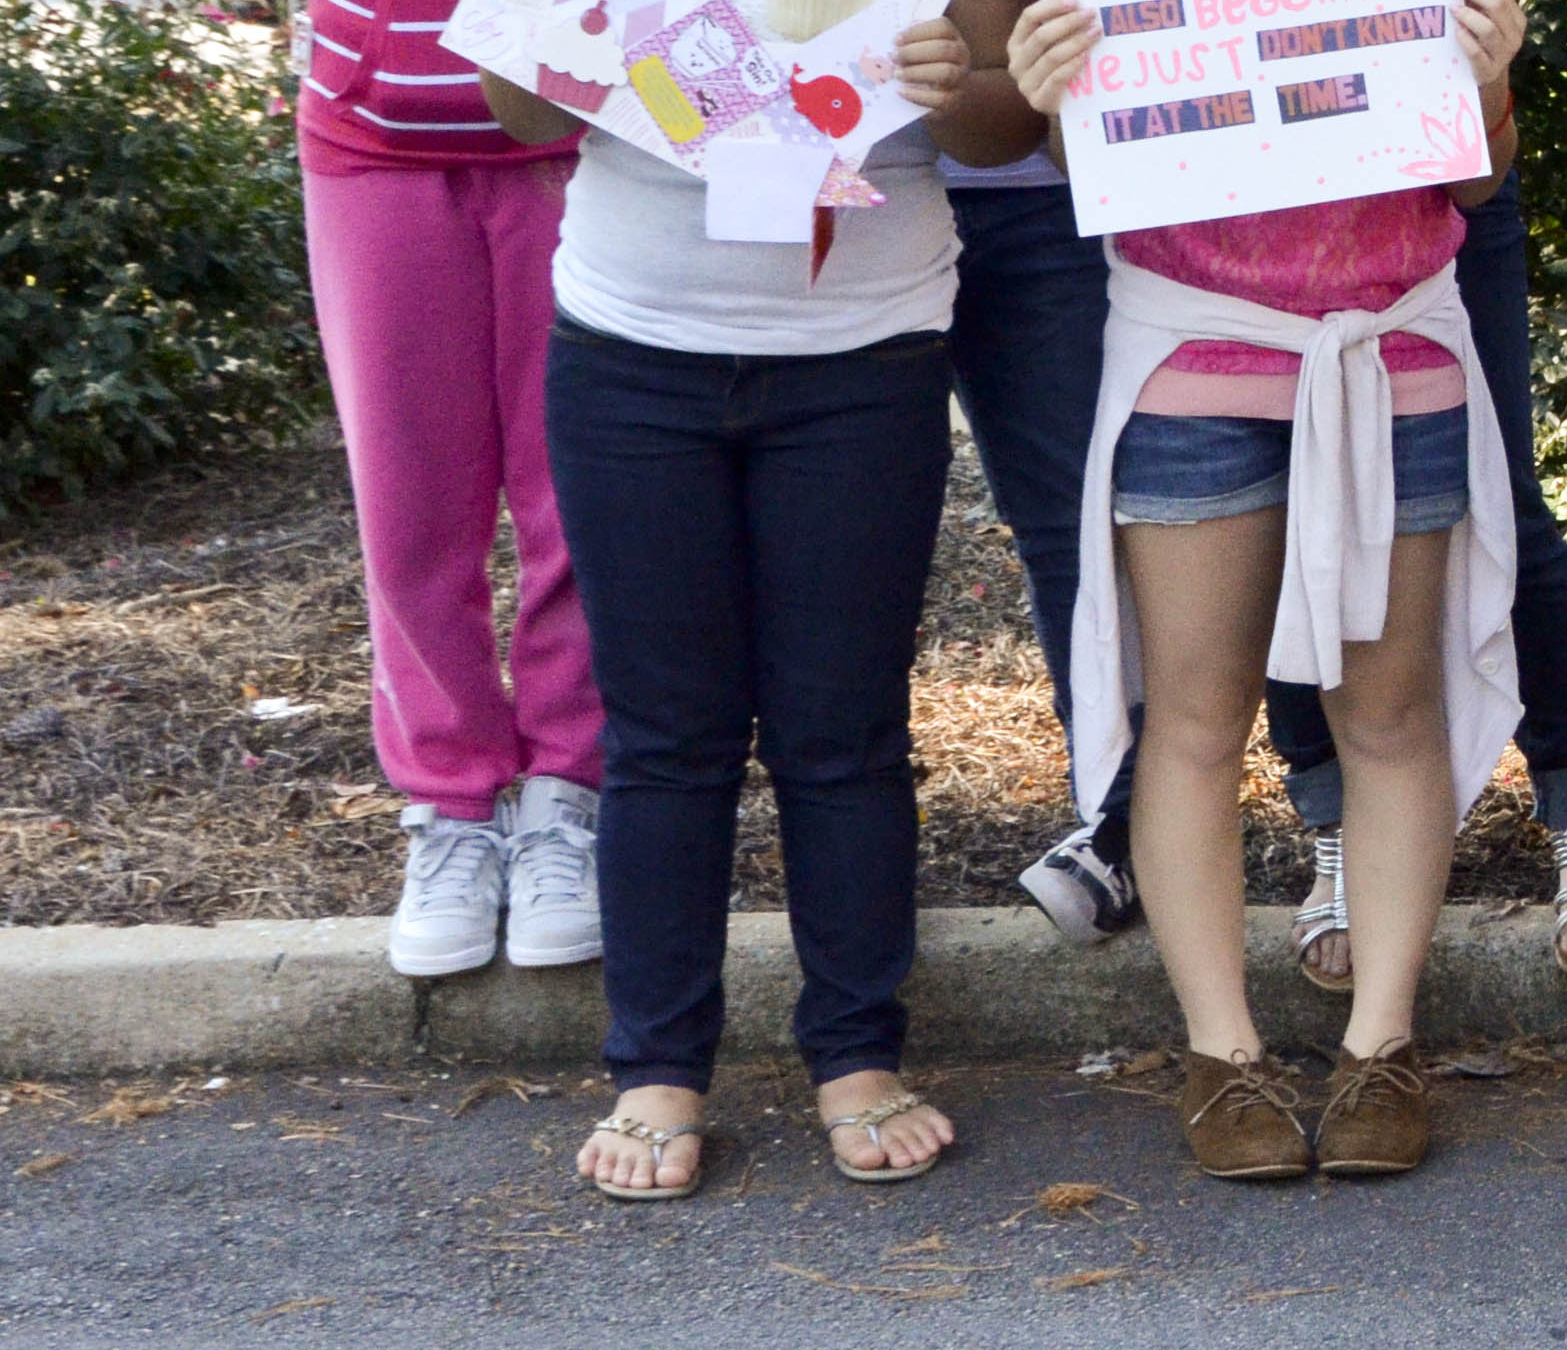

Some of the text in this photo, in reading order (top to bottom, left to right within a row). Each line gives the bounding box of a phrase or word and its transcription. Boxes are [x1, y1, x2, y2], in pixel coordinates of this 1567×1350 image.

[1109, 1, 1182, 34] ALSO
[1260, 21, 1350, 61] DON'T
[1357, 7, 1445, 46] KNOW
[1105, 77, 1368, 143] IT AT THE TIME.
